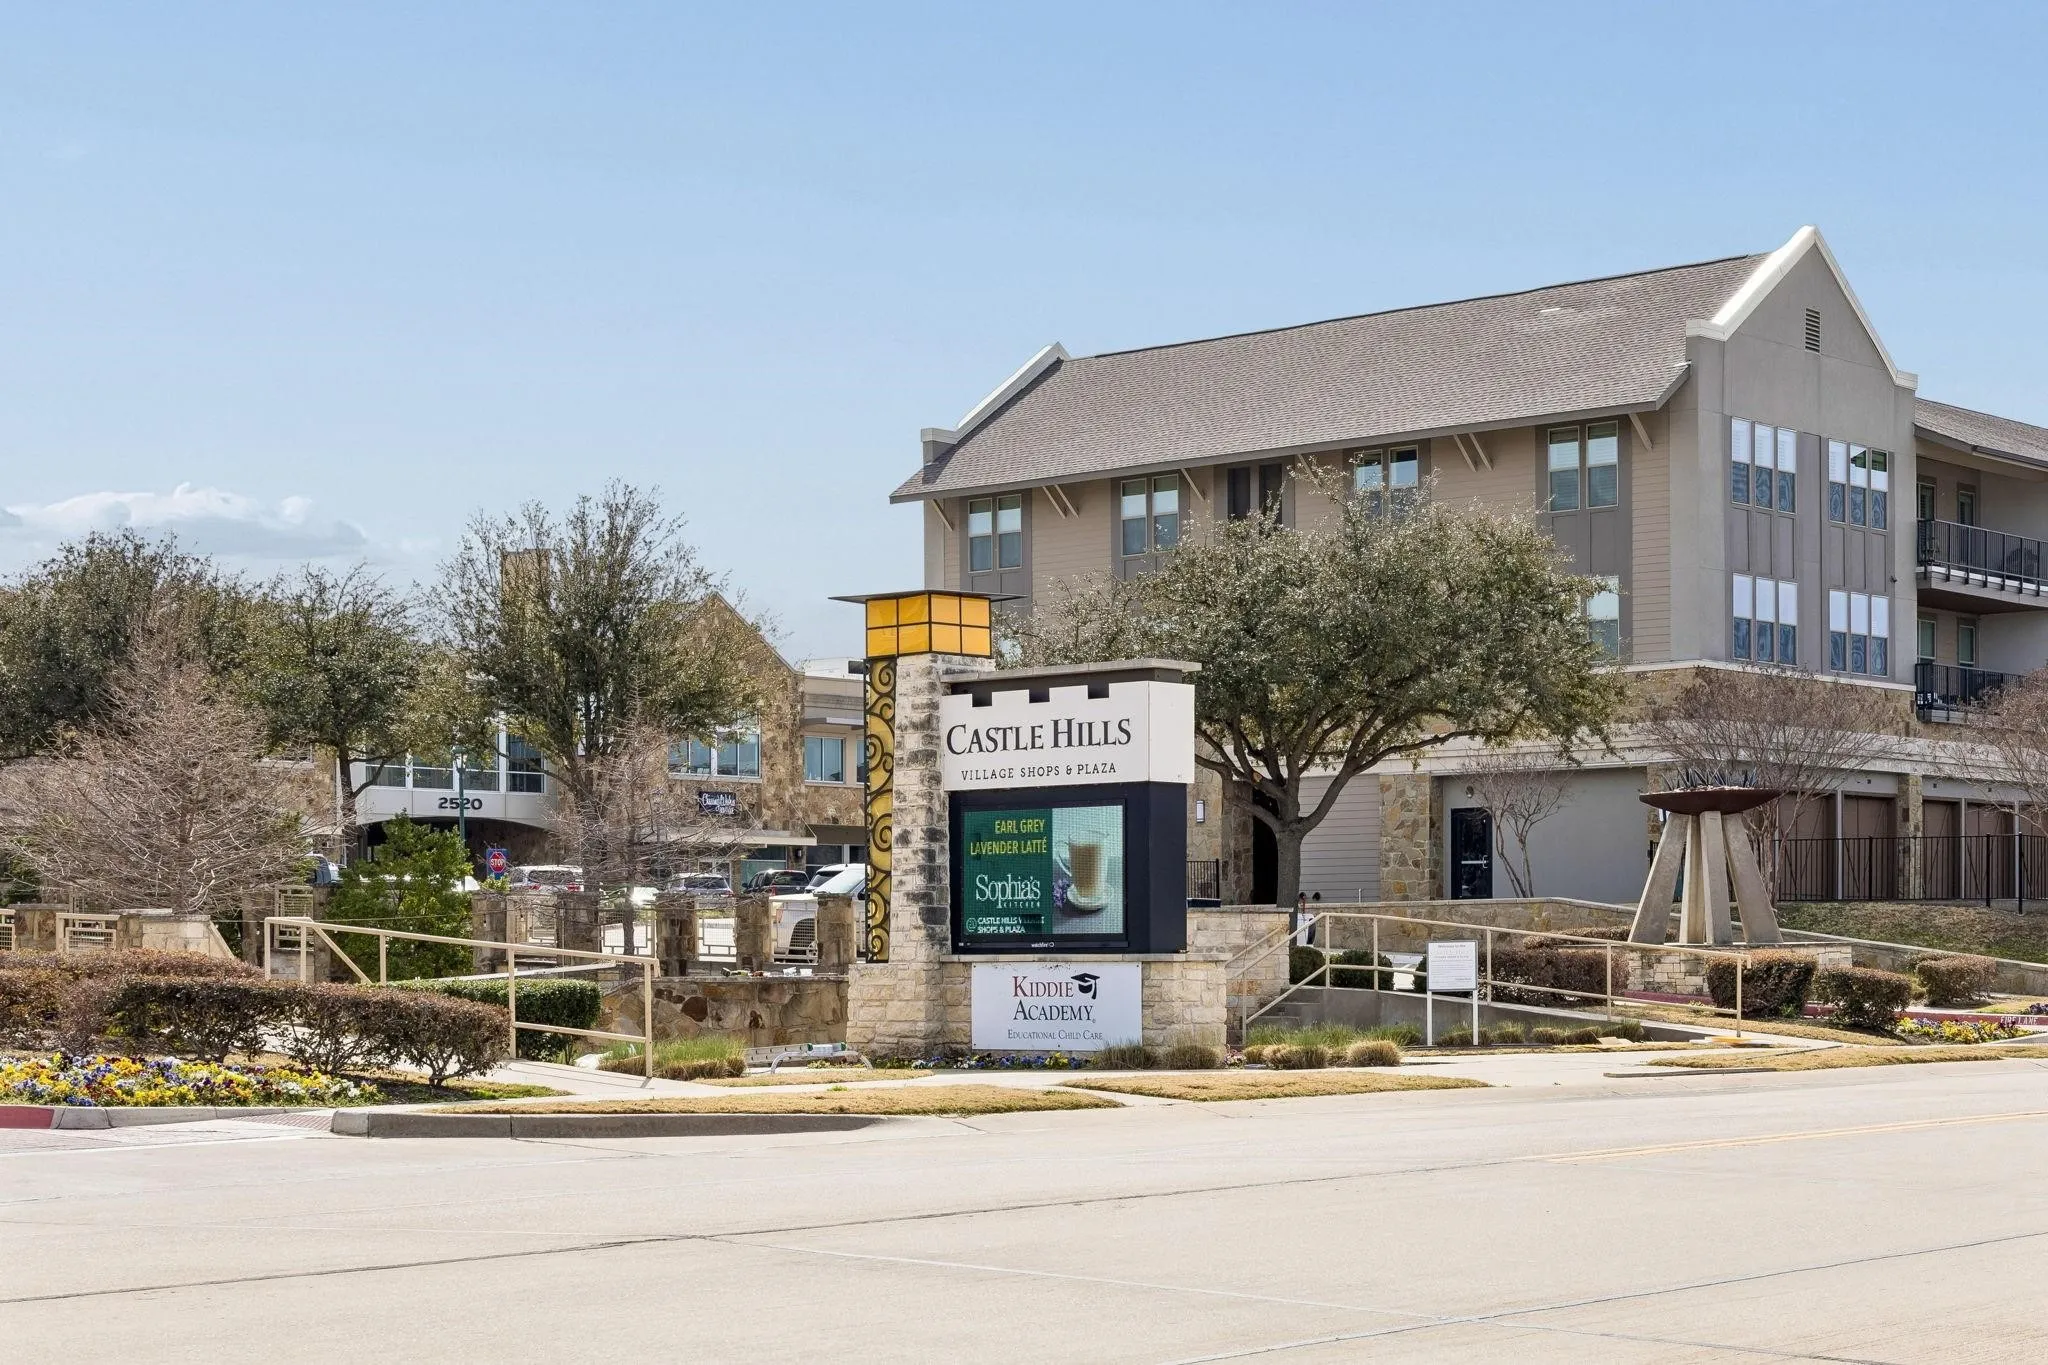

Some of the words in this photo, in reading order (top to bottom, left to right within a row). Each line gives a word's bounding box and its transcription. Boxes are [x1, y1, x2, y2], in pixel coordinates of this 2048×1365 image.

[946, 724, 1044, 755] CASTLE
[1050, 717, 1132, 749] HILLS
[961, 767, 1014, 781] VILLAGE
[1020, 765, 1060, 778] SHOPS
[1065, 765, 1073, 775] &
[1077, 763, 1116, 775] PLAZA
[438, 797, 483, 810] 2520
[995, 821, 1018, 834] EARL
[1020, 819, 1045, 833] GREY
[970, 841, 1019, 855] LAVENDER
[976, 873, 1041, 909] Sophia's
[1001, 916, 1017, 924] HILLS
[977, 926, 998, 934] SHOPS
[1005, 925, 1026, 934] PLAZA
[1012, 975, 1074, 998] KIDDIE
[1013, 999, 1094, 1021] ACADEMY
[2018, 1017, 2038, 1025] LANE
[1008, 1029, 1057, 1040] EDUCATIONAL
[1058, 1029, 1081, 1040] CHILD
[1082, 1029, 1103, 1040] CARE
